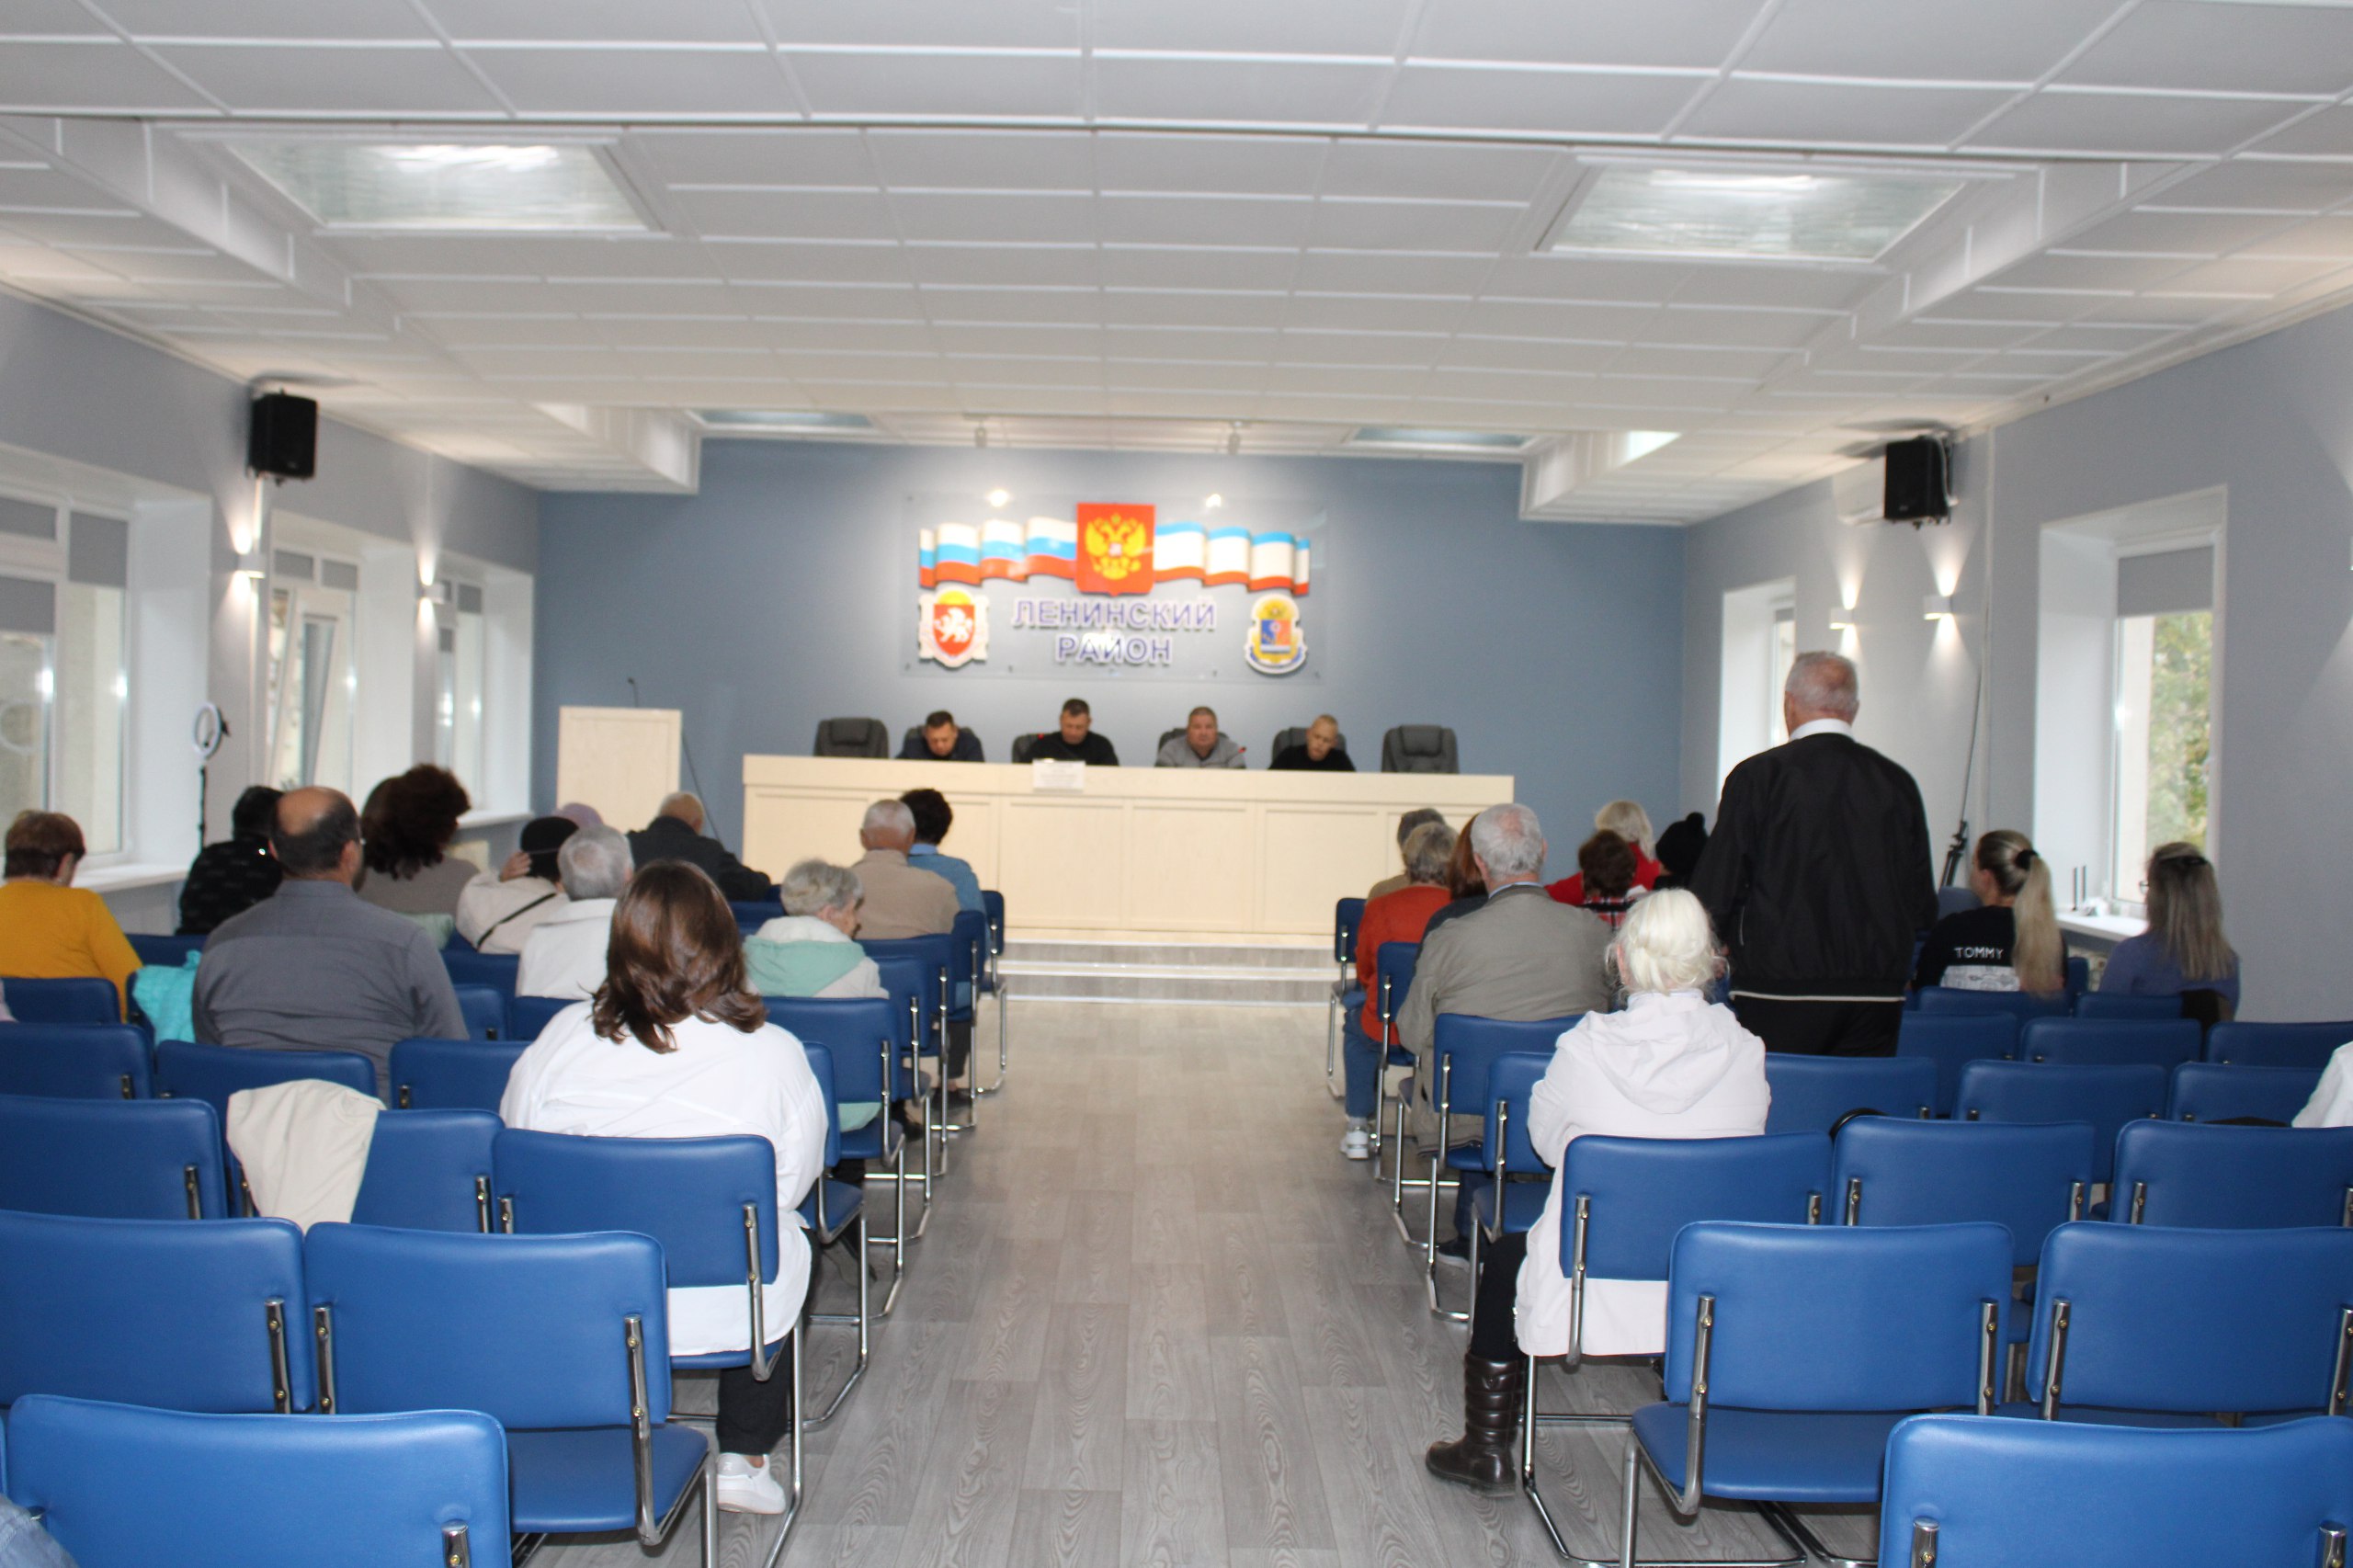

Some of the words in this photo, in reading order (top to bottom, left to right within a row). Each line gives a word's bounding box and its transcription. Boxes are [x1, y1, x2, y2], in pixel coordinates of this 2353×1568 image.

[1013, 597, 1216, 627] ЛЕНИНСКИЙ
[1057, 631, 1171, 662] РАЙОН
[1954, 947, 2004, 960] TOMMY
